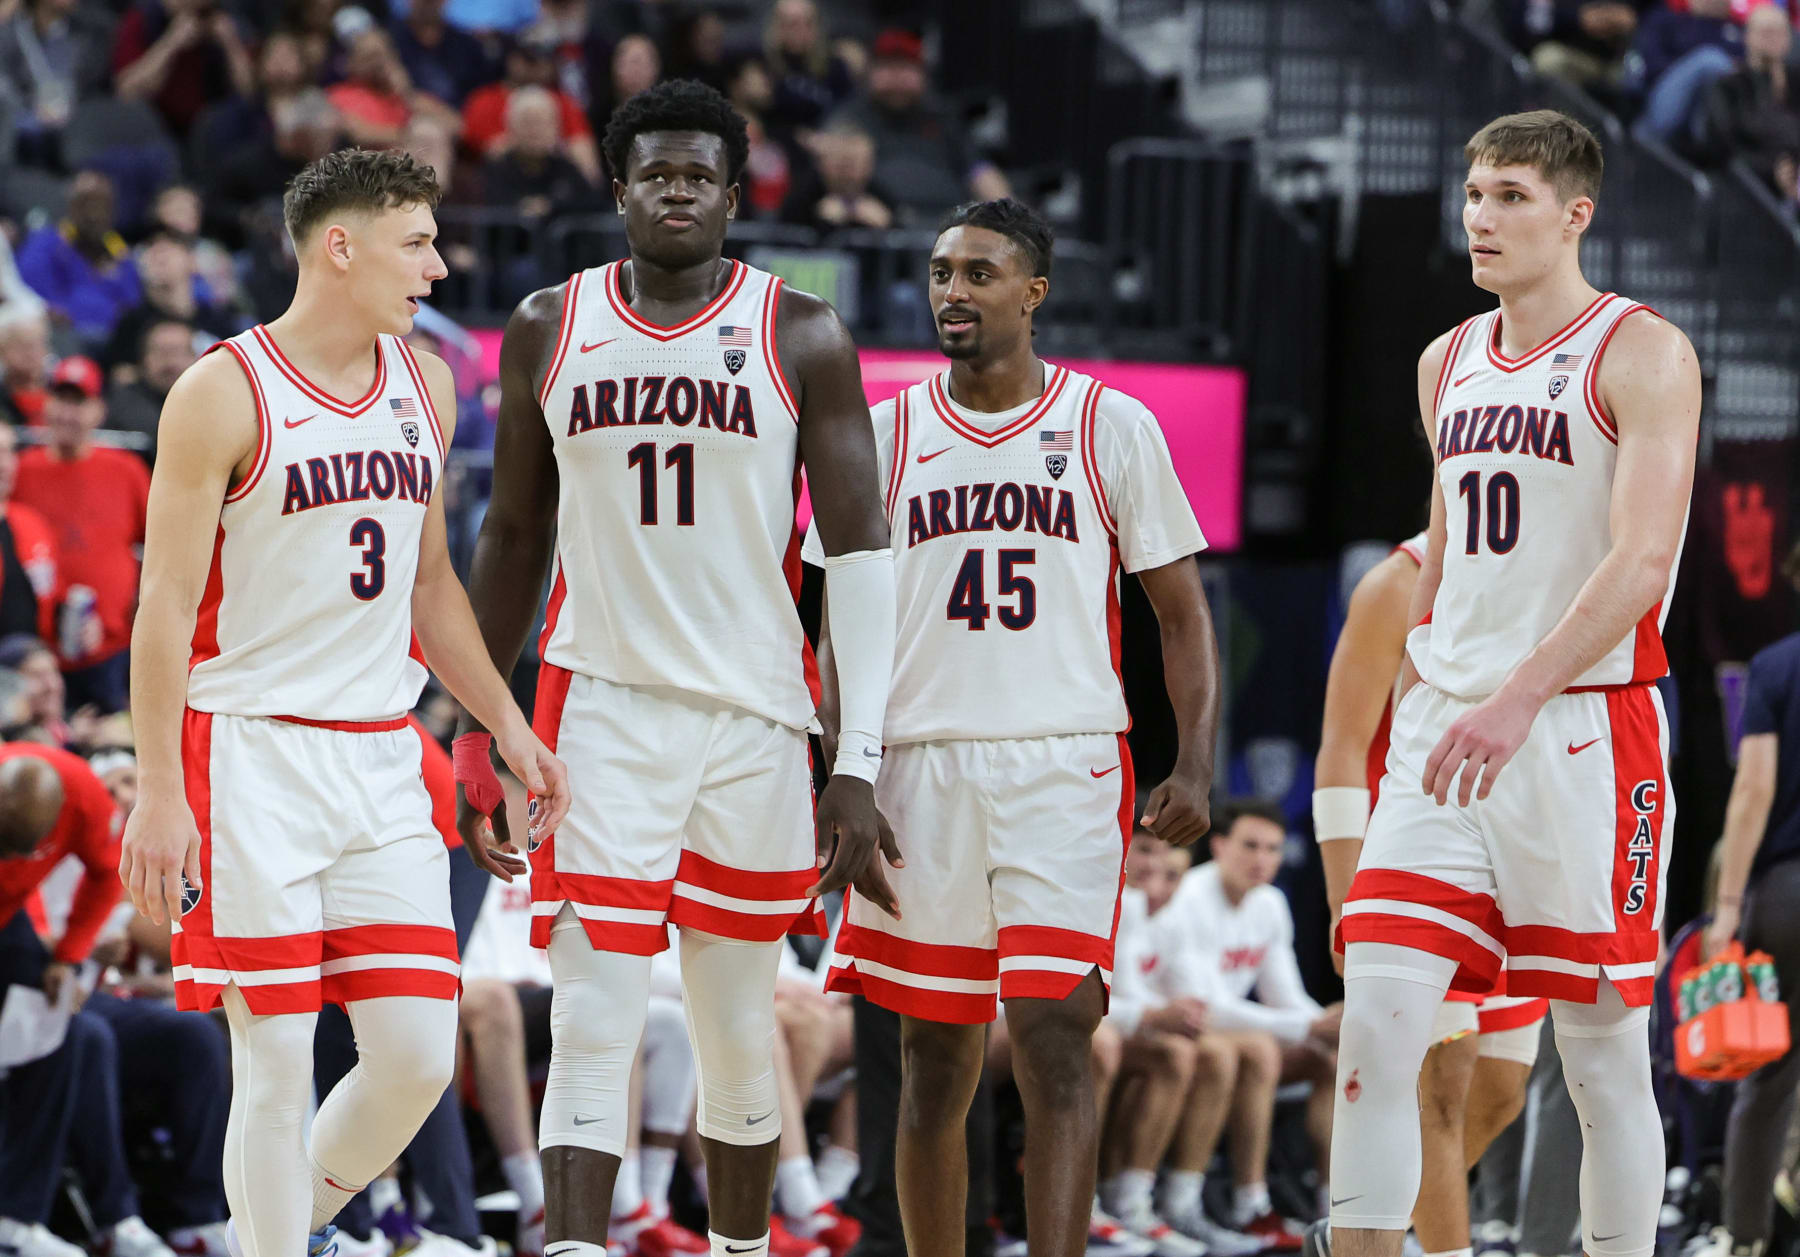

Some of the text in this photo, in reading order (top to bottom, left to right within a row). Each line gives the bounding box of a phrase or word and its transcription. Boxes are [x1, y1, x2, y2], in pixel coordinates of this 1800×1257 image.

[567, 376, 758, 438] ARIZONA
[1437, 404, 1574, 466] ARIZONA
[281, 450, 432, 516] ARIZONA
[627, 442, 695, 526] 11
[908, 481, 1080, 549] ARIZONA
[1459, 470, 1520, 555] 10
[350, 517, 386, 601] 3
[946, 548, 1037, 631] 45
[1623, 780, 1658, 915] CATS
